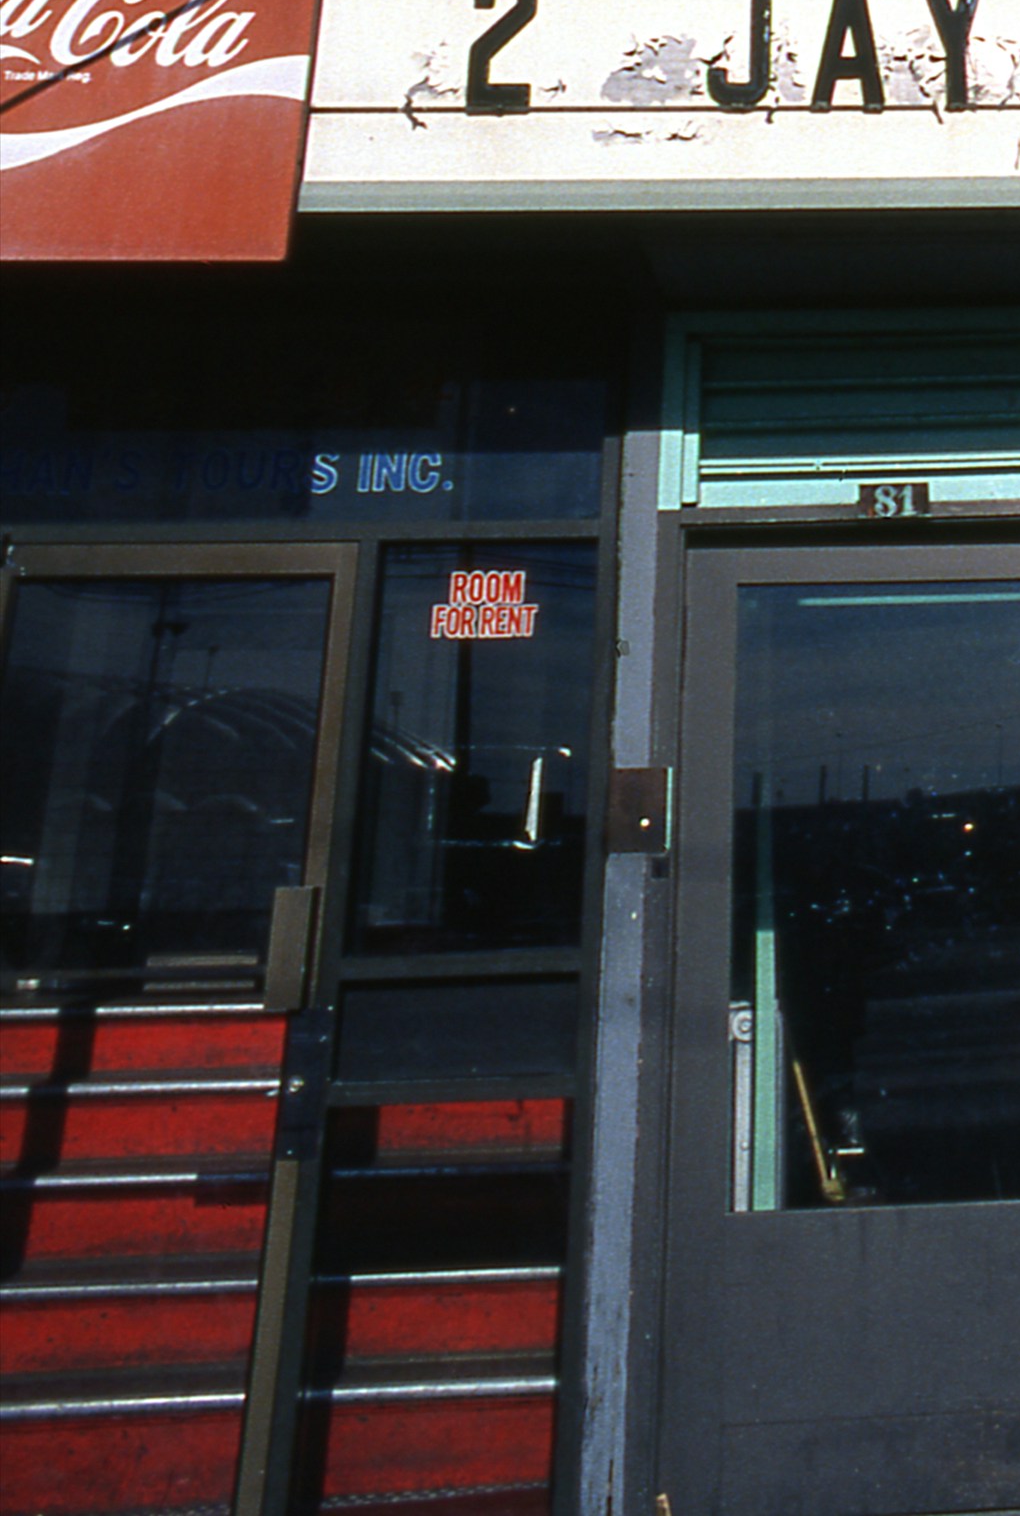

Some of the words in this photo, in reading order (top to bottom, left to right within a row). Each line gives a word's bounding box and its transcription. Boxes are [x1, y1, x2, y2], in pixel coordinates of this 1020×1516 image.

[356, 451, 454, 494] INC.
[873, 484, 917, 518] 81
[450, 571, 527, 605] ROOM
[430, 604, 478, 638] FOR
[478, 604, 539, 638] RENT
